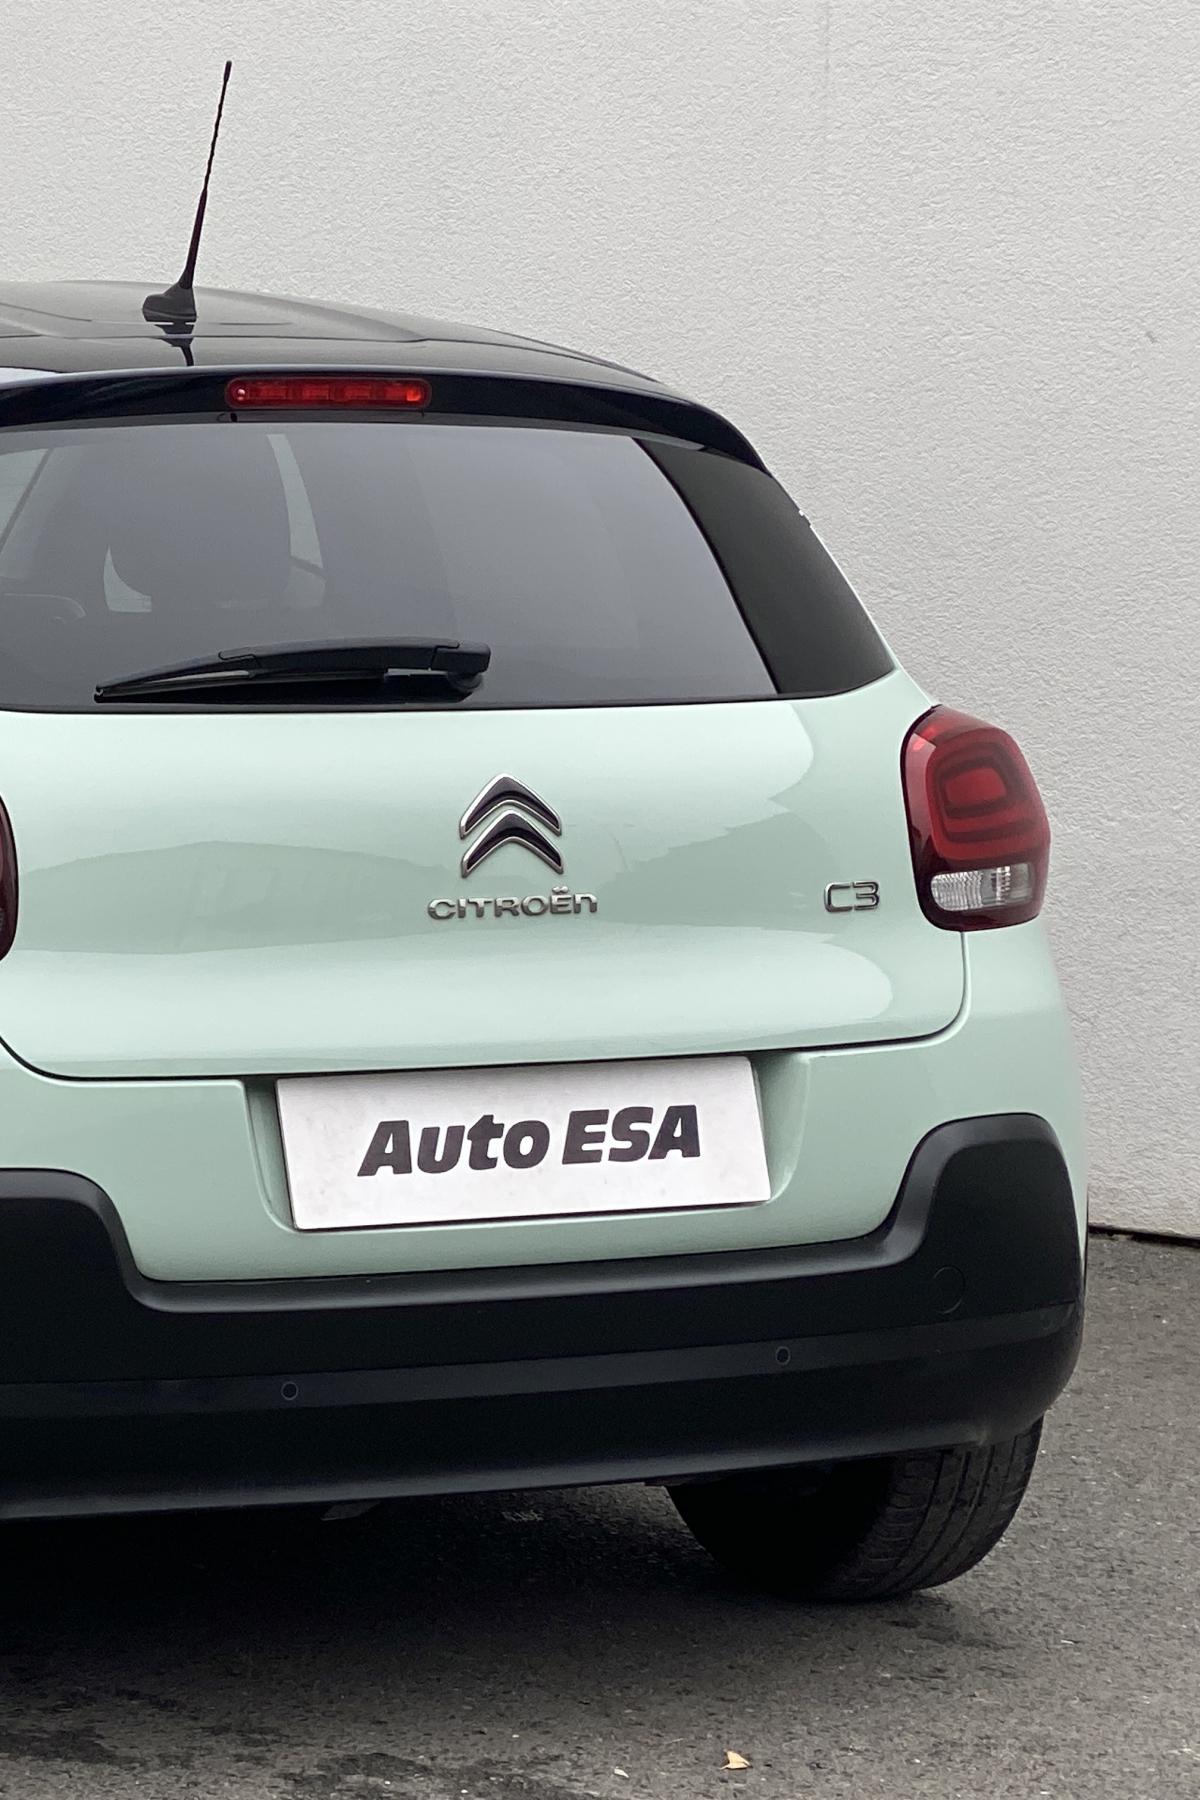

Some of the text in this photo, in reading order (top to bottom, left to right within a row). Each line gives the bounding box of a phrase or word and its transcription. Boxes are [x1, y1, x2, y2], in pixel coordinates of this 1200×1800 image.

[823, 880, 880, 913] C3
[357, 1104, 701, 1177] Auto ESA
